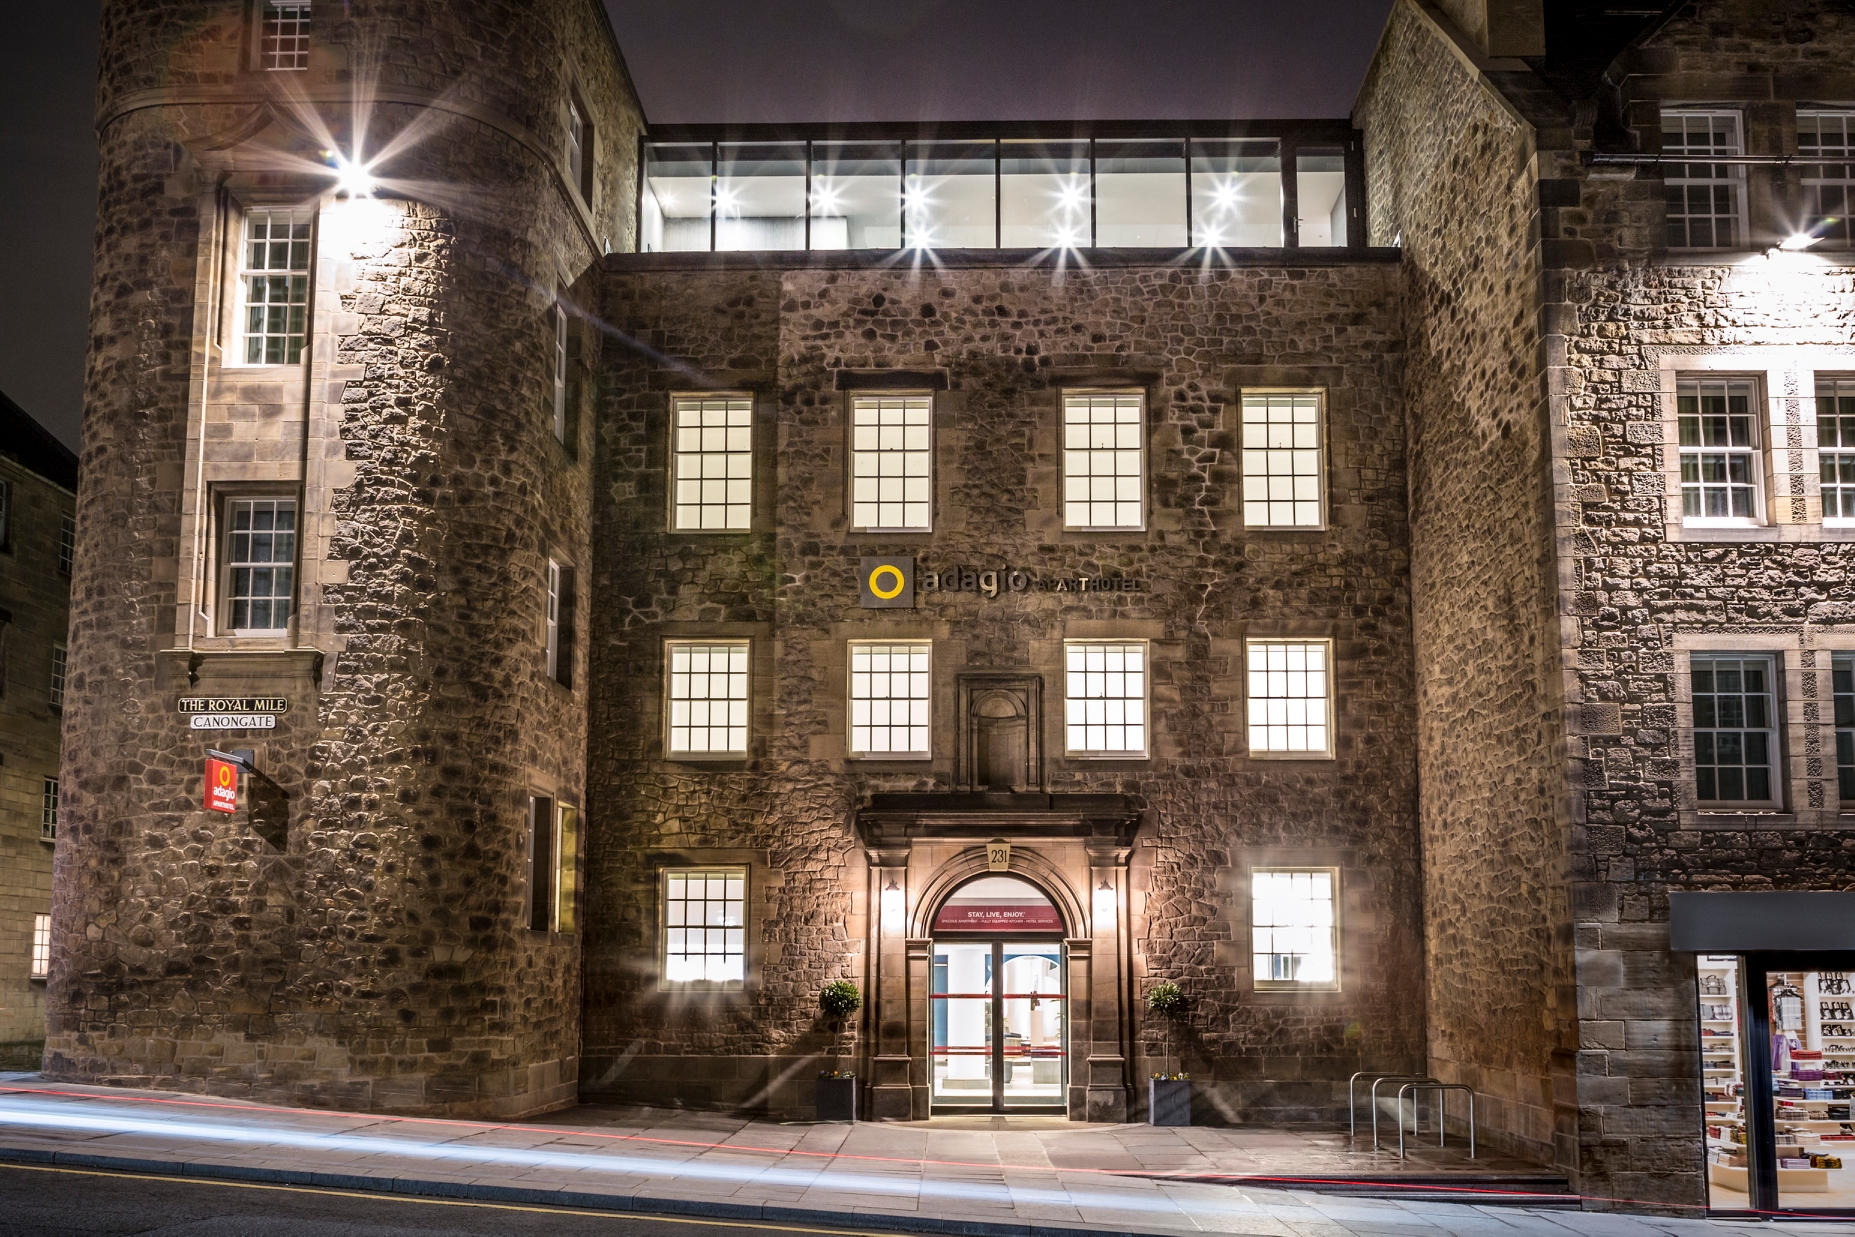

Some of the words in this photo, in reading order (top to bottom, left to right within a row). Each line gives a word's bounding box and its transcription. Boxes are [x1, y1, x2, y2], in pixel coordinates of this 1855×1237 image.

[922, 564, 1028, 598] adagio
[1037, 577, 1141, 592] APARTHOTEL
[181, 699, 205, 711] THE
[208, 699, 249, 711] ROYAL
[254, 699, 284, 711] MILE
[193, 716, 272, 727] CANONGATE
[213, 785, 235, 801] adagio
[991, 849, 1007, 863] 231
